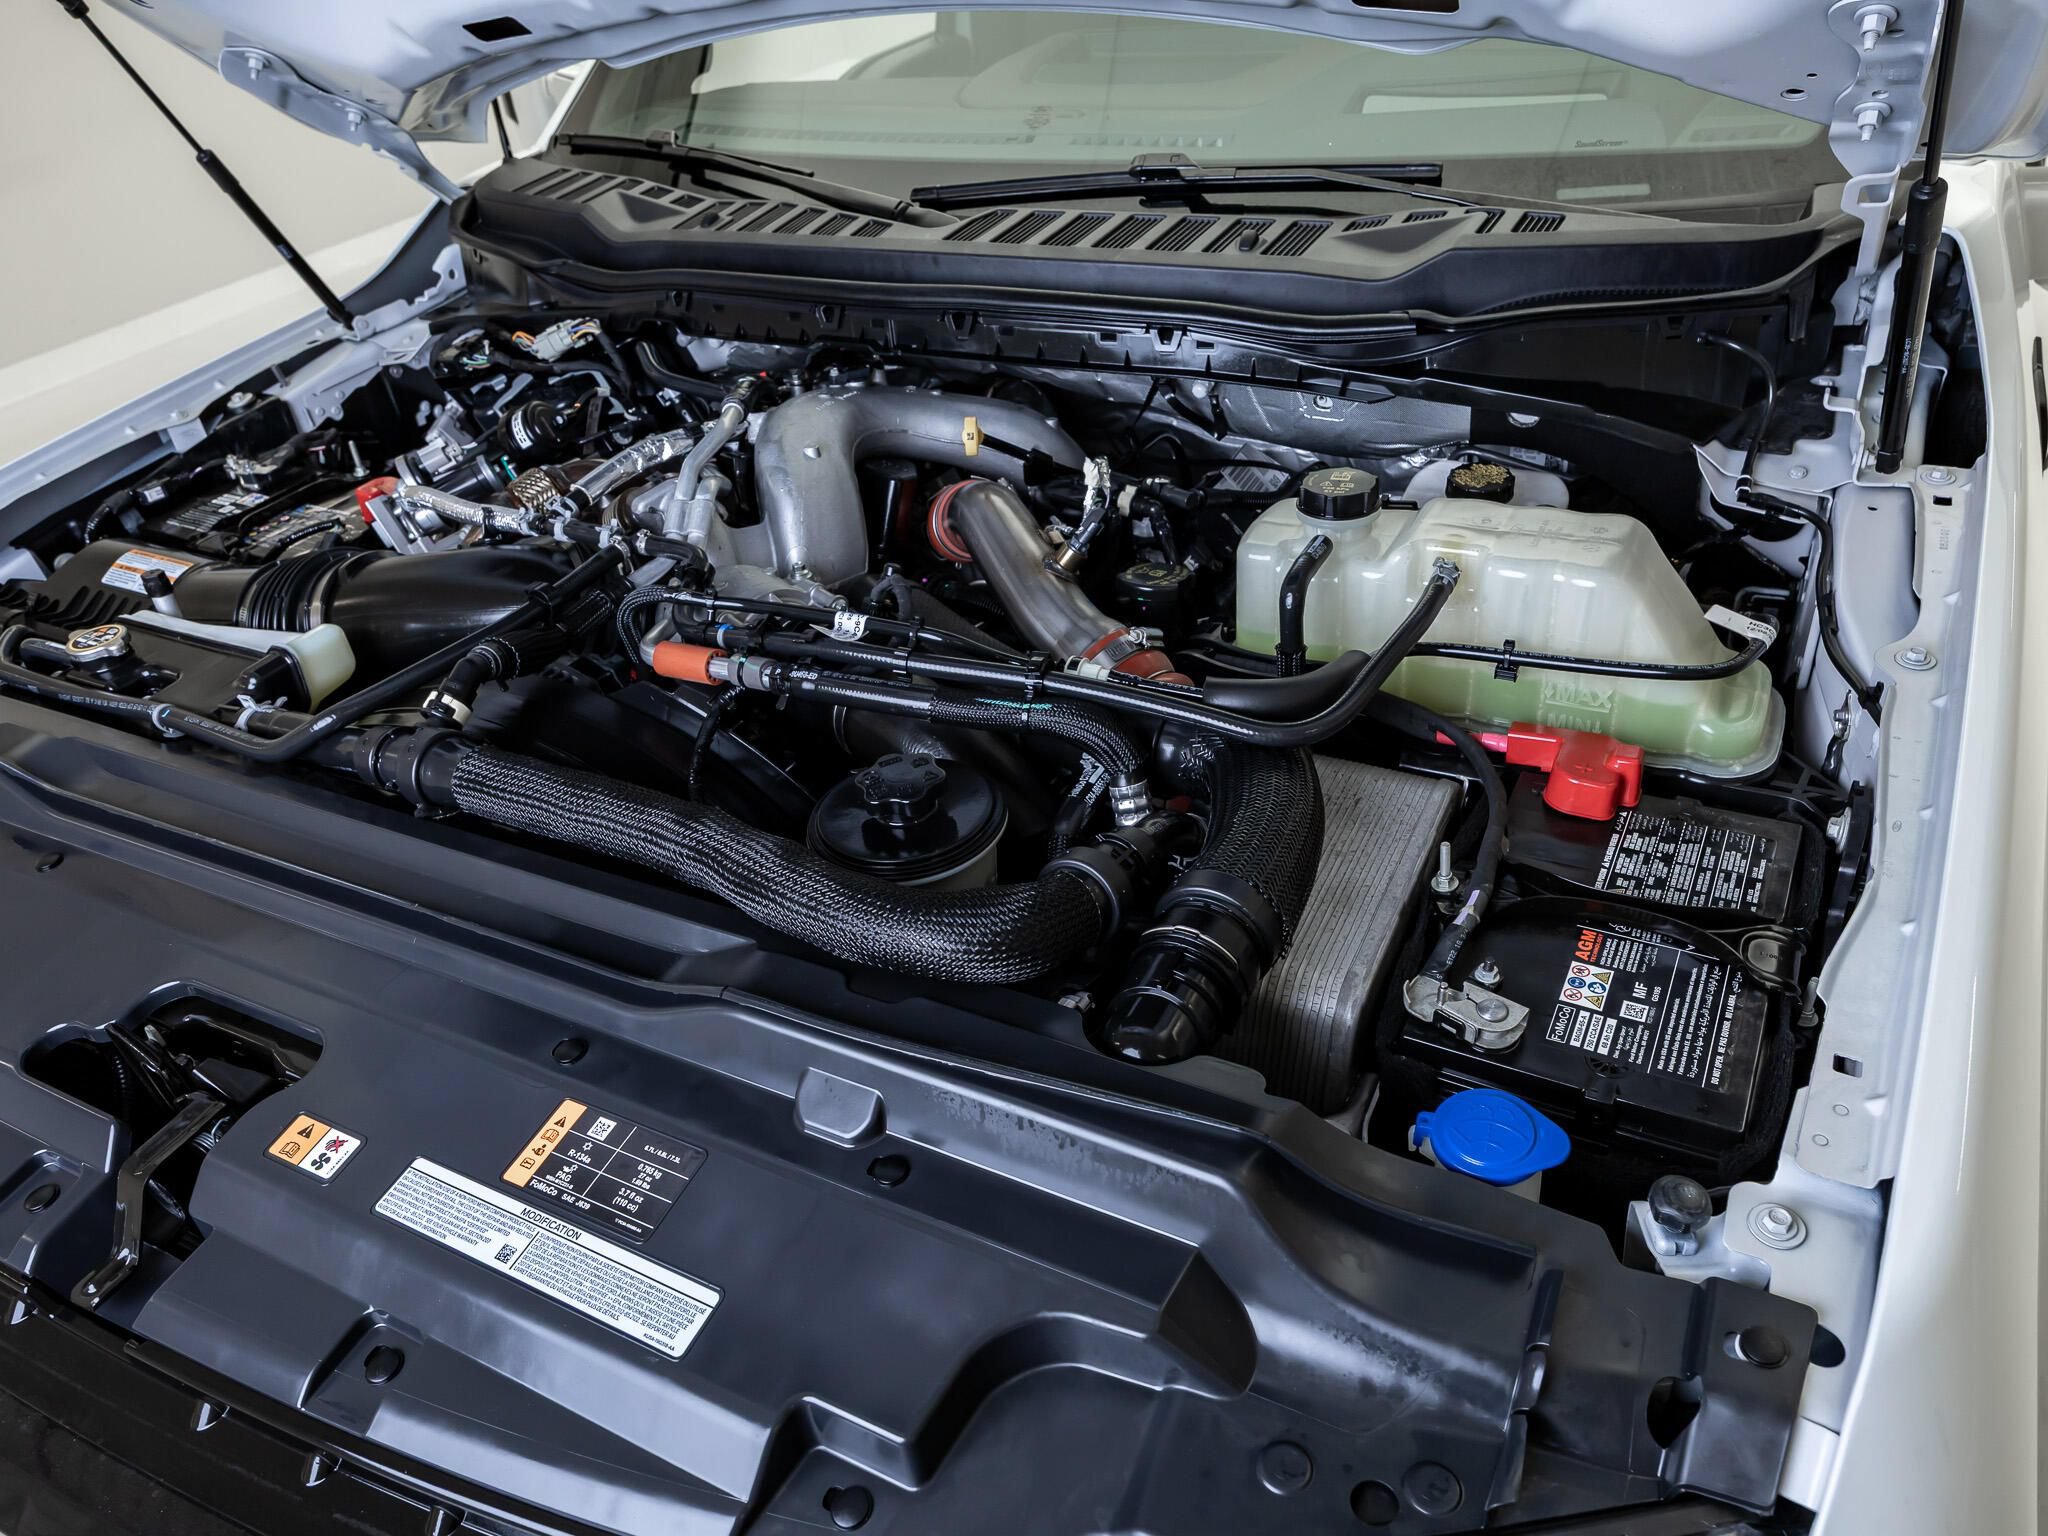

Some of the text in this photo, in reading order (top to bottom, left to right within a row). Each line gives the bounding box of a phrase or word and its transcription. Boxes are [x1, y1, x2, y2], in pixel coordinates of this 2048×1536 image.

[1575, 930, 1596, 960] AGM
[1632, 981, 1647, 998] MF
[1551, 1006, 1570, 1040] FoMoCo
[1573, 1015, 1587, 1042] BAGM-65-A
[1589, 1016, 1601, 1039] CCA/SAE
[567, 1149, 591, 1163] R-134a
[555, 1171, 571, 1181] PAG
[637, 1163, 662, 1179] 0.765 kg
[529, 1179, 590, 1209] FoMoCo SAE J639
[612, 1196, 628, 1207] (110
[618, 1188, 630, 1196] 3.7
[521, 1208, 581, 1239] MODIFICATION
